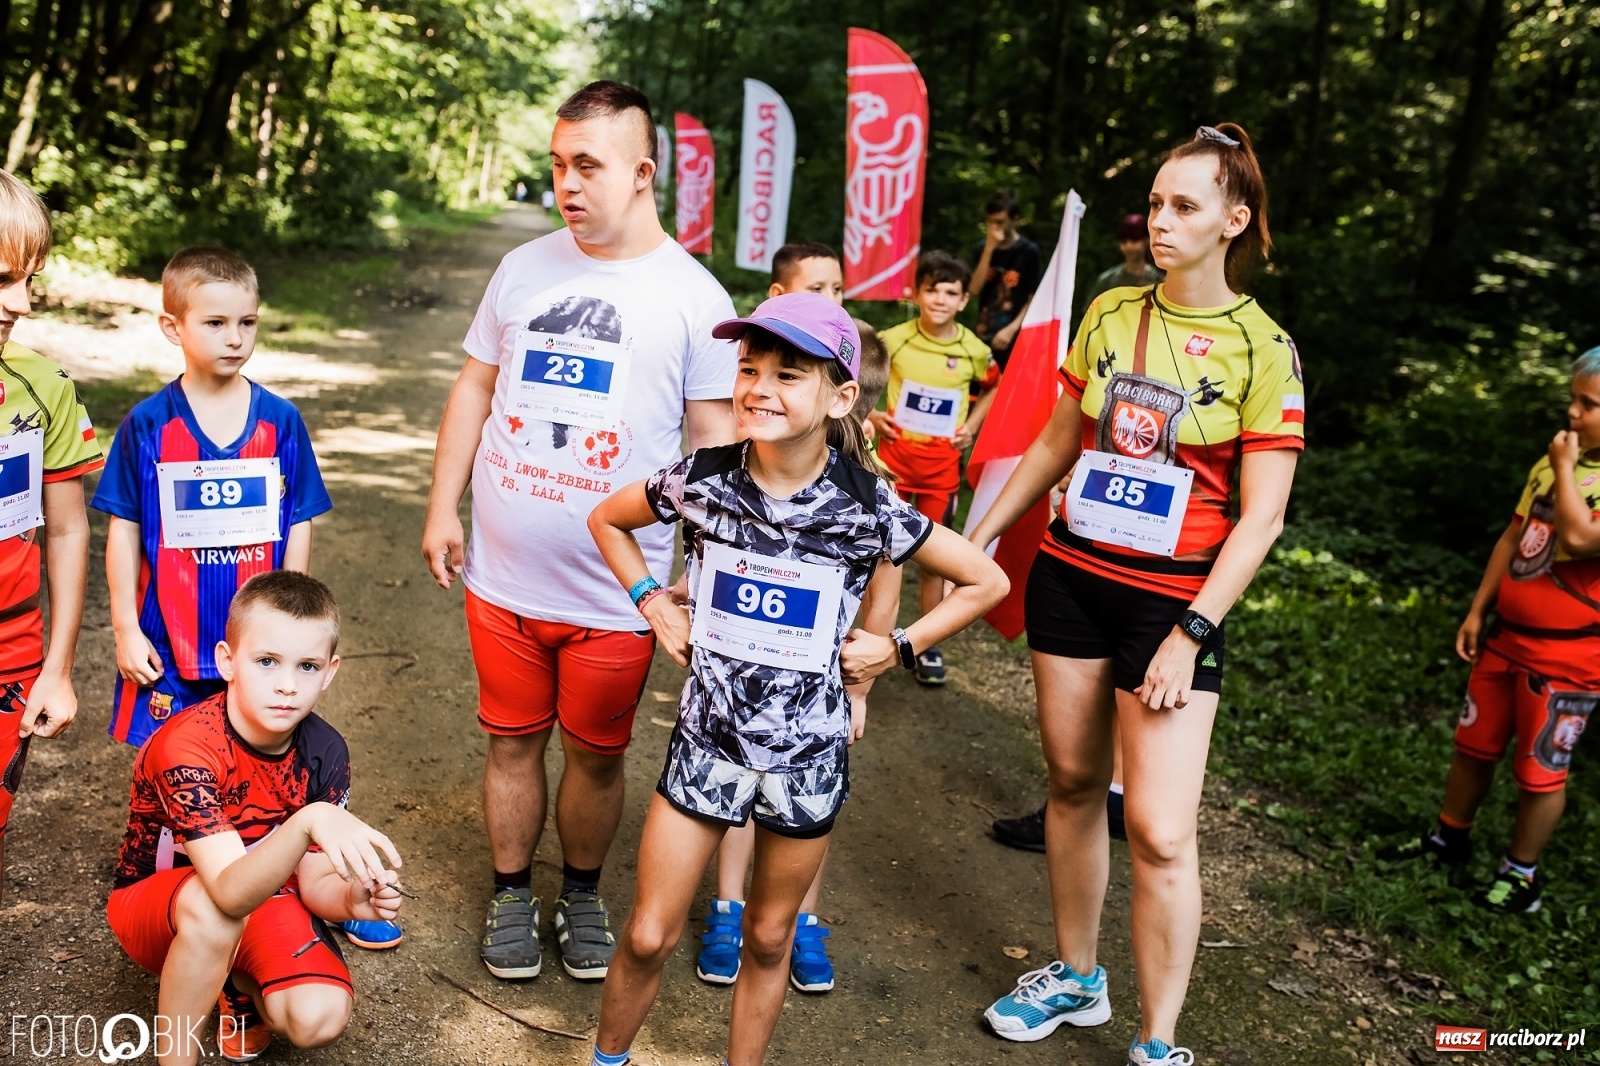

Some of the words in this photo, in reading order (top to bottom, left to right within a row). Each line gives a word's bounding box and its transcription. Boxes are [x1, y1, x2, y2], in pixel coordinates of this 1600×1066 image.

[543, 355, 585, 384] 23
[918, 397, 943, 413] 87
[484, 449, 508, 469] LIDIA
[514, 462, 612, 494] LWOW-EBERLE
[200, 479, 242, 507] 89
[500, 475, 520, 492] PS.
[530, 485, 565, 503] LALA
[1105, 476, 1147, 507] 85
[749, 563, 801, 579] TROPEMWILCZYM
[736, 583, 787, 619] 96
